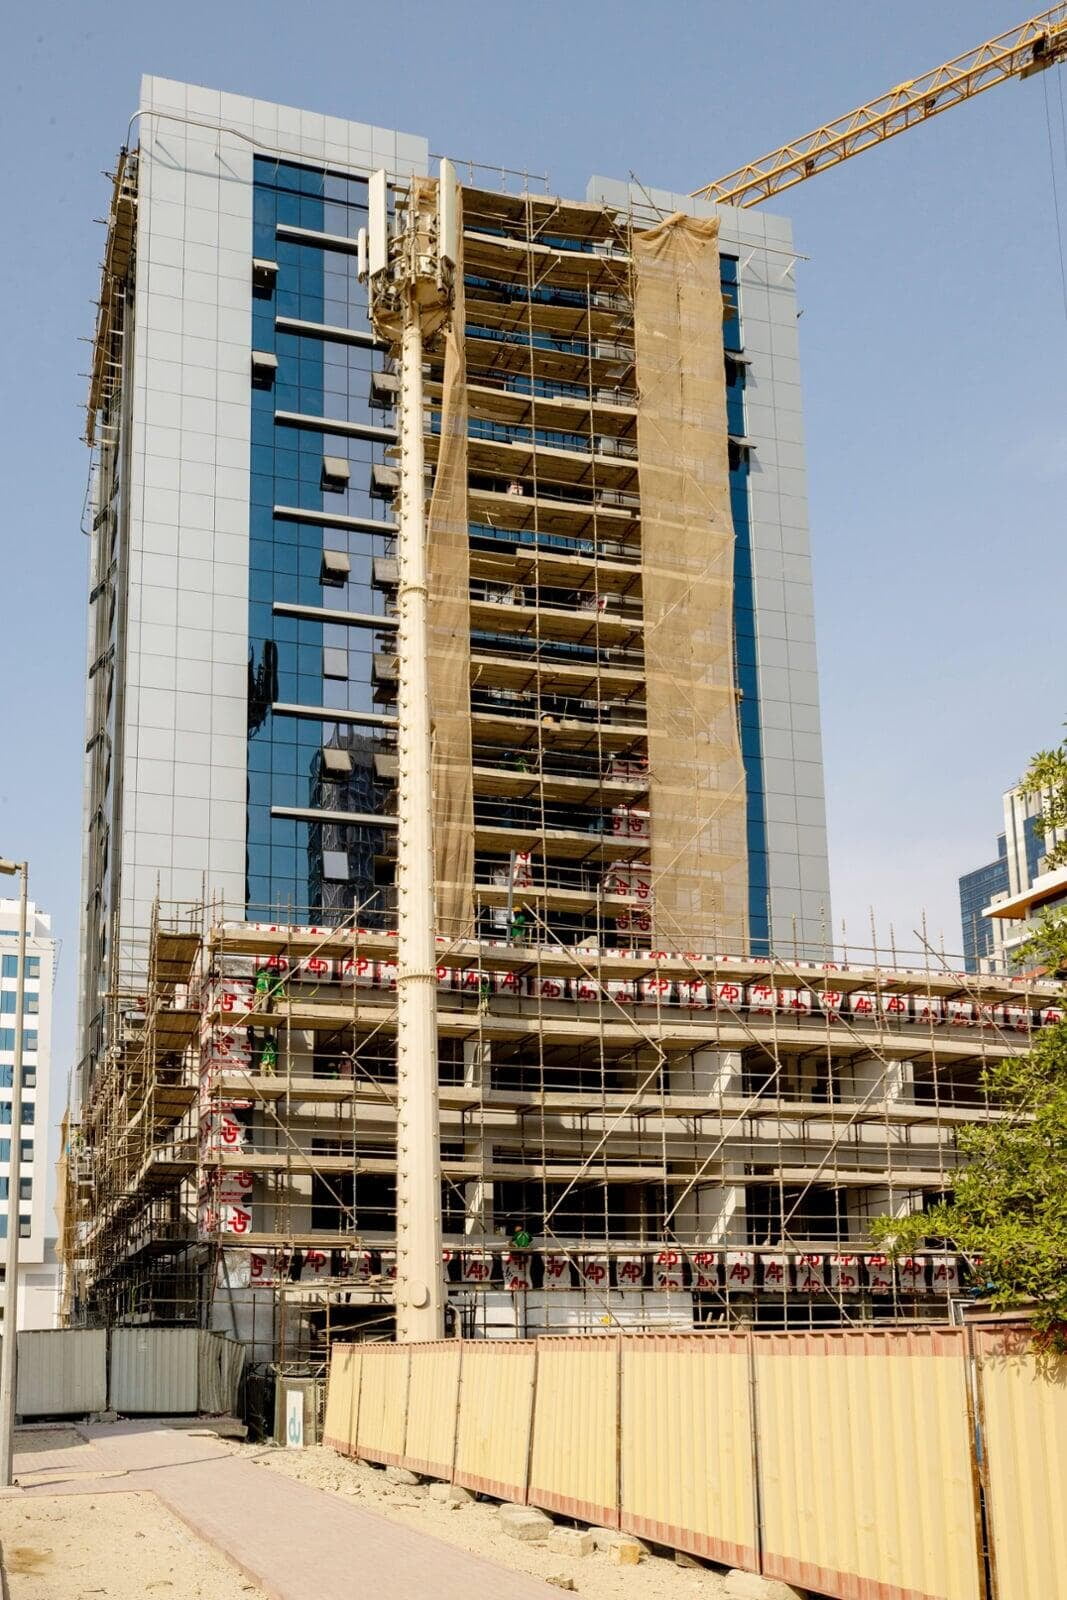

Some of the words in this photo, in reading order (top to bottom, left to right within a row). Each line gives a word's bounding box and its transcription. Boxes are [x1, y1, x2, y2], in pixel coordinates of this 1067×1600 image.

[720, 983, 739, 1003] AP
[620, 1261, 642, 1283] AP
[729, 1262, 750, 1284] AP
[288, 1405, 302, 1444] du
